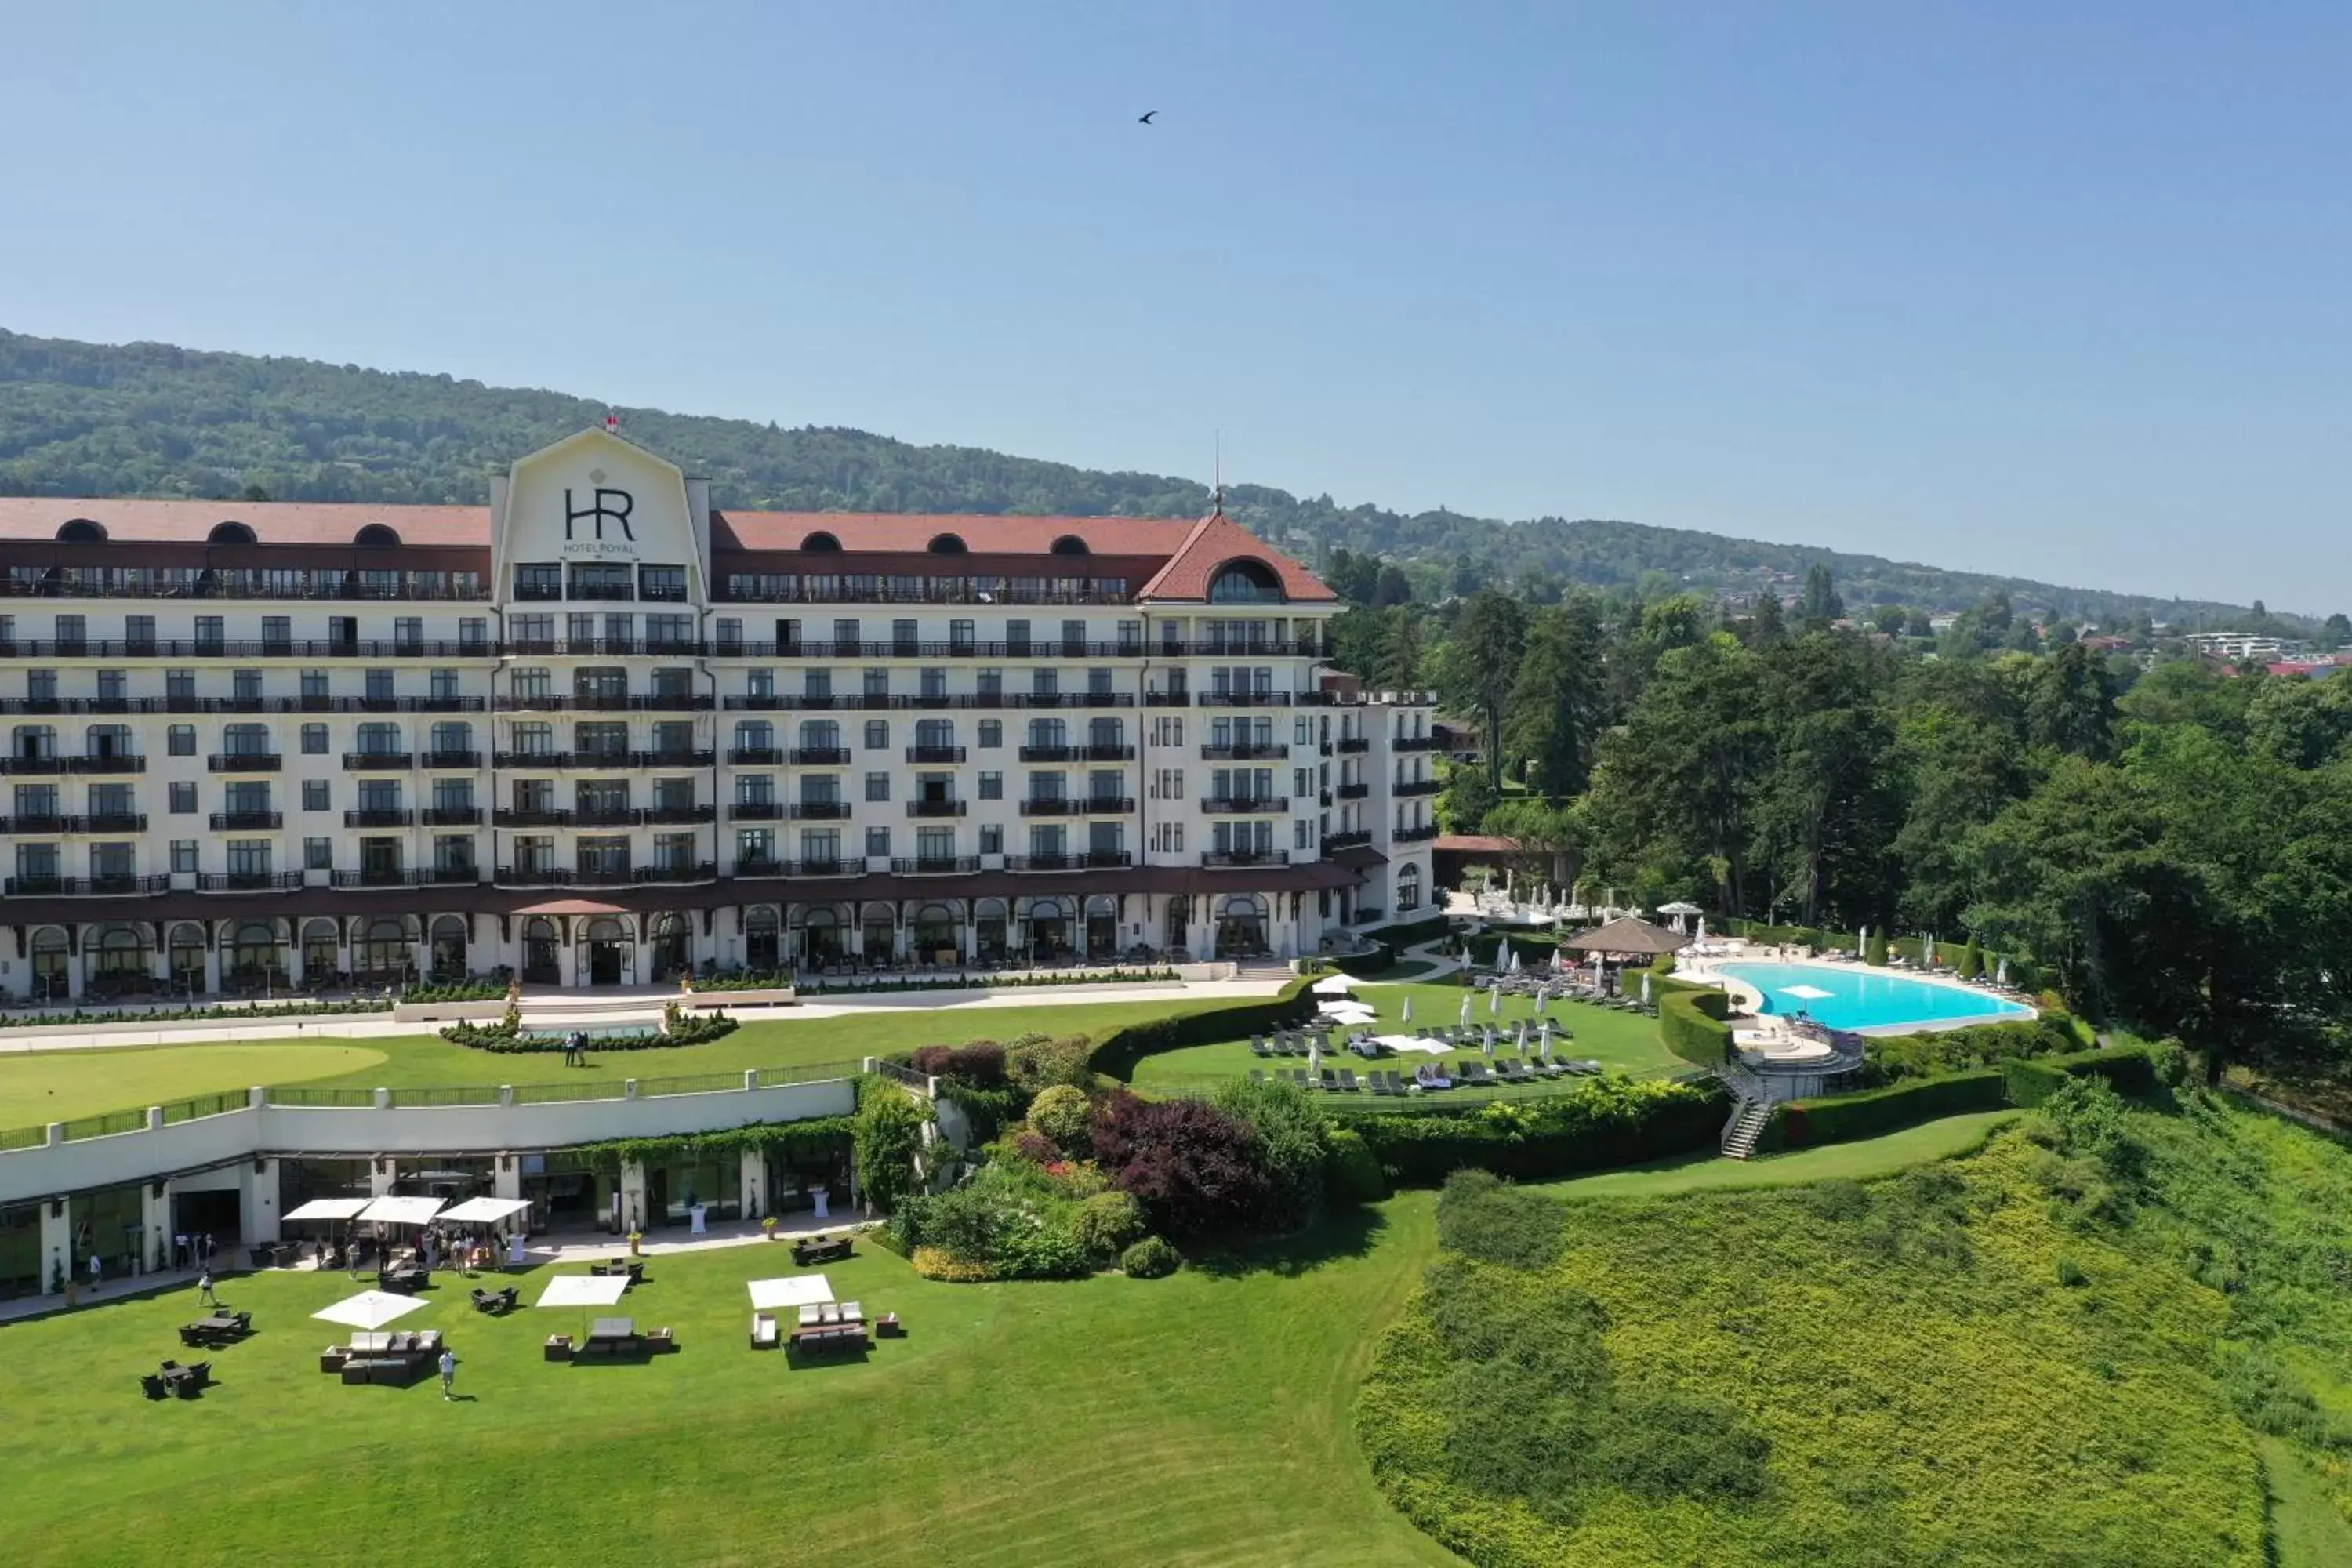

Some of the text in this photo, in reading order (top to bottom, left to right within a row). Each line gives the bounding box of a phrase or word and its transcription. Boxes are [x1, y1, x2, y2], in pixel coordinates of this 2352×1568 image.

[564, 488, 636, 541] HR
[564, 543, 635, 554] HOTEL ROYAL
